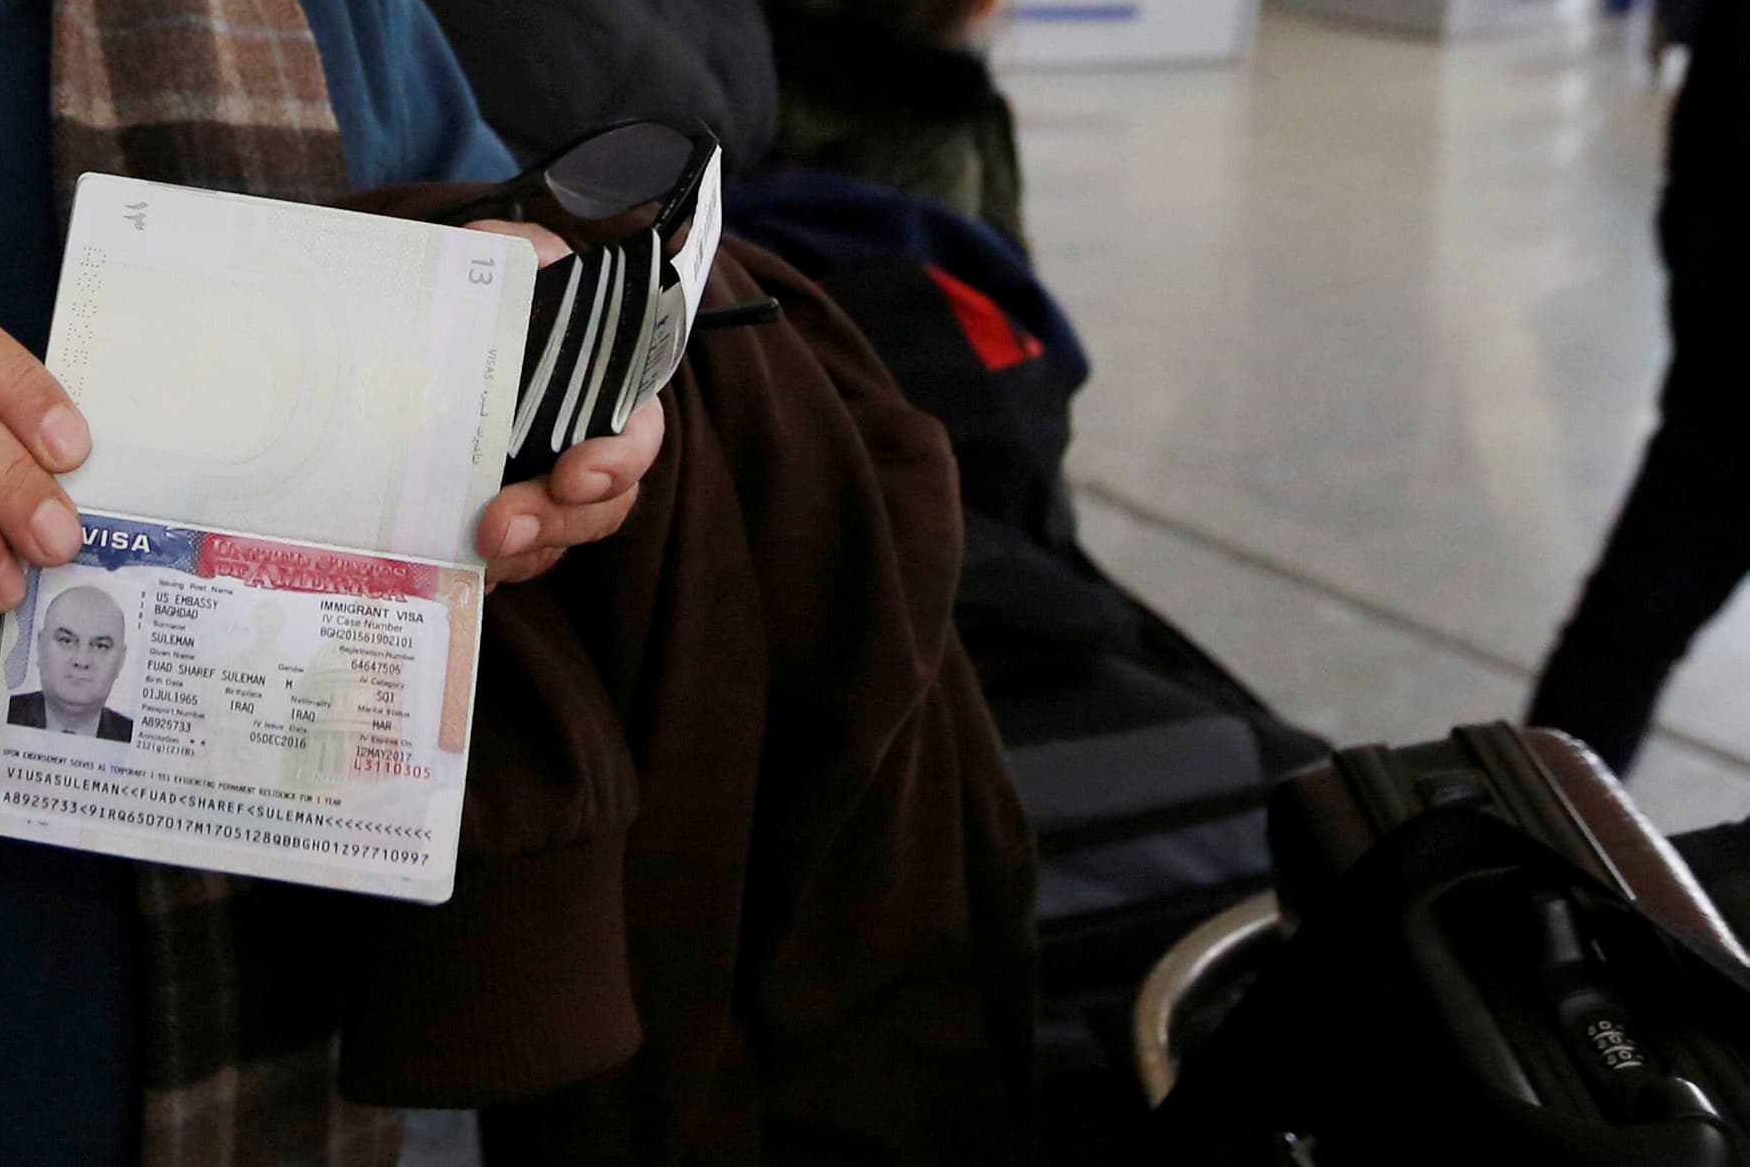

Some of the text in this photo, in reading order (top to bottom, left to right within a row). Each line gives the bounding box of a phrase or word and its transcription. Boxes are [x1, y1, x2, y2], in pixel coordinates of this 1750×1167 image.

[468, 258, 496, 286] 13
[60, 246, 107, 406] A89257
[484, 348, 497, 381] VISAS
[81, 527, 150, 553] VISA
[156, 592, 218, 610] US EMBASSY
[154, 604, 199, 619] BAGHDAD
[320, 600, 425, 624] IMMIGRANT VISA
[336, 617, 361, 627] Case
[364, 620, 403, 633] Number
[151, 632, 195, 647] SULEMAN
[147, 659, 266, 686] FUAD SHAREF SULEMAN
[230, 700, 255, 714] IRAQ
[291, 709, 316, 723] IRAQ
[249, 733, 306, 750] 05DEC2016
